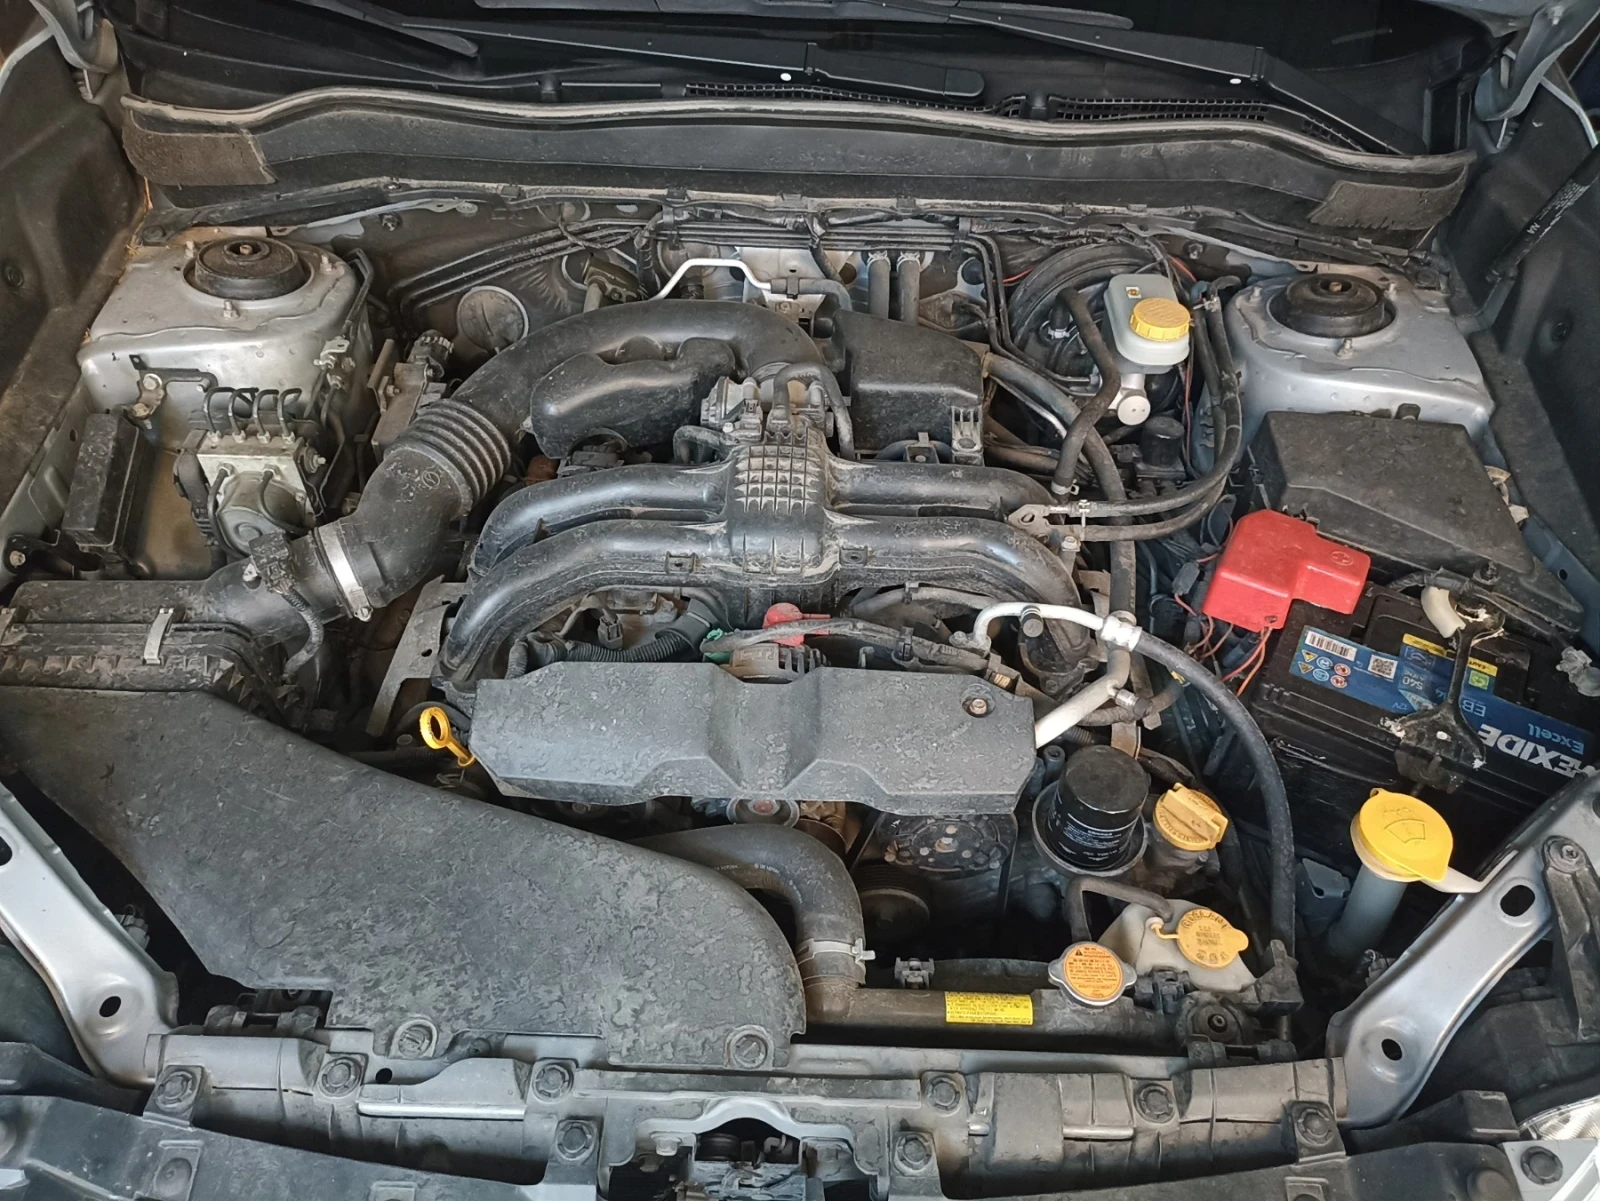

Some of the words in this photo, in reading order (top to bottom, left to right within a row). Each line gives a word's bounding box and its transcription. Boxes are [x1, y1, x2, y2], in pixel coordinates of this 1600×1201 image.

[1402, 676, 1424, 690] 540
[1478, 723, 1582, 778] EXIDE
[1527, 723, 1585, 755] Excell
